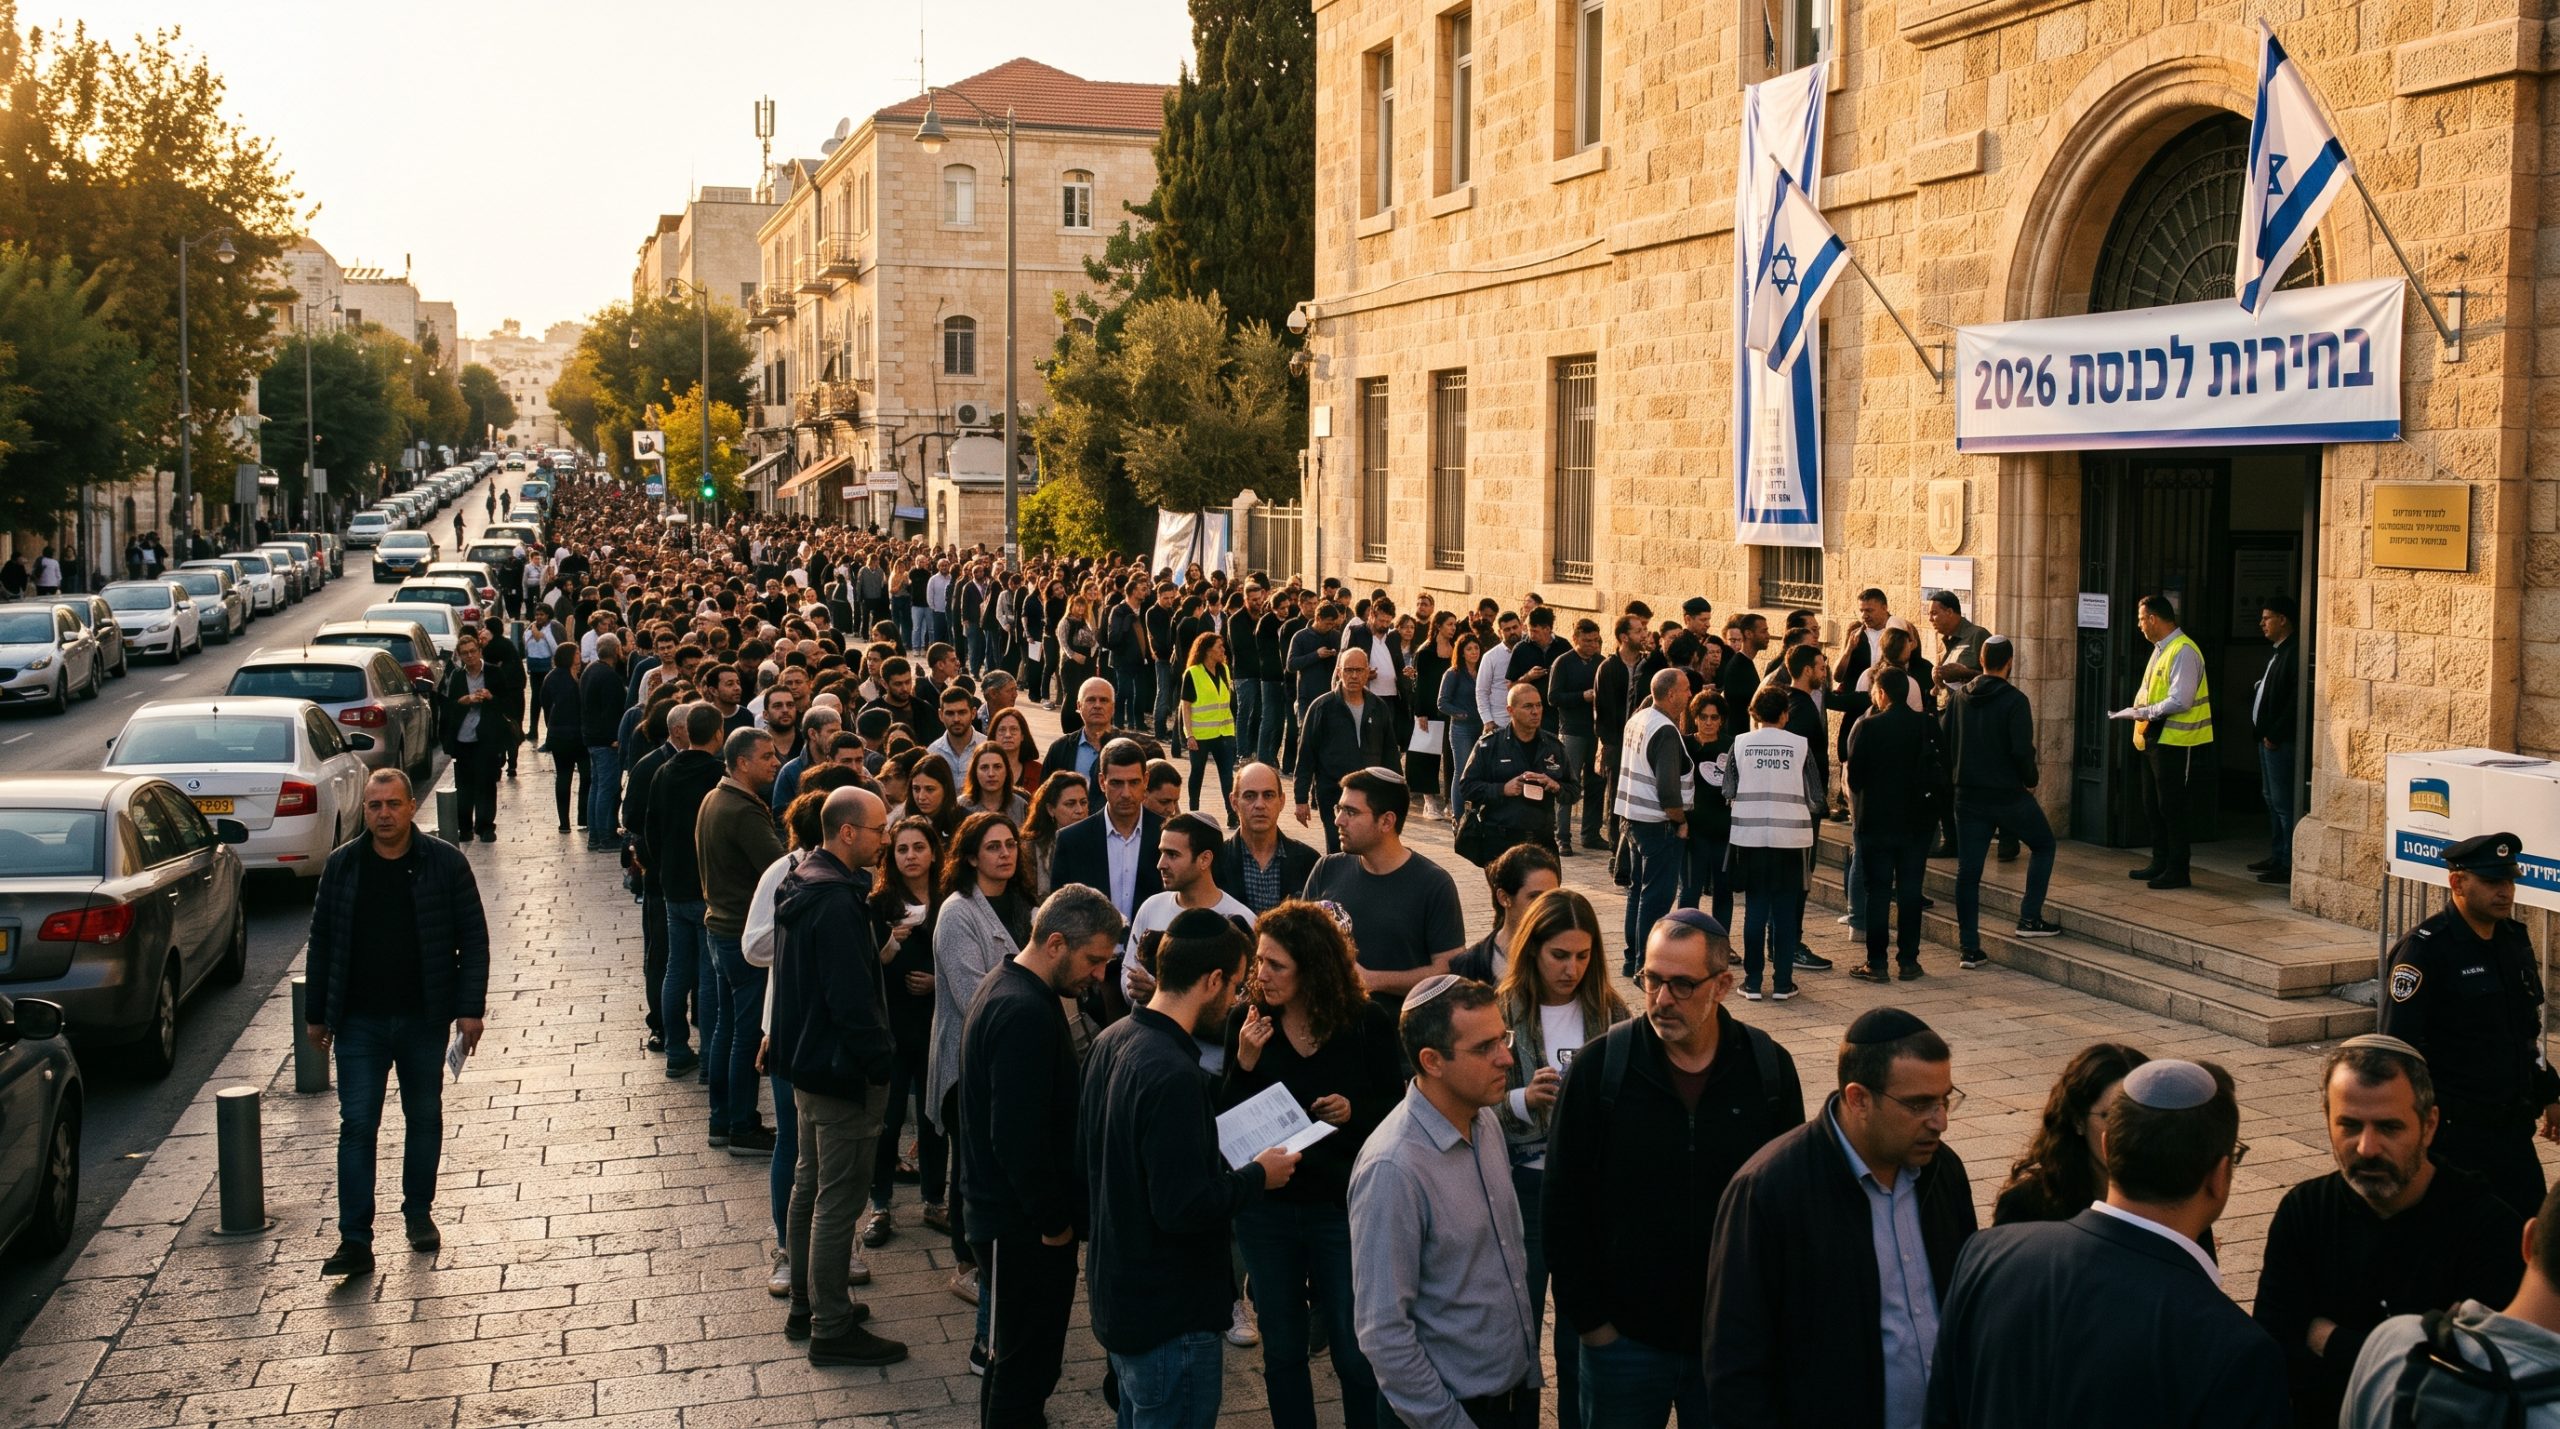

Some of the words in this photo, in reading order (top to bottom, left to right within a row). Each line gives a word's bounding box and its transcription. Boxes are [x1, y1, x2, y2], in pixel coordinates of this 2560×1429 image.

[1974, 354, 2057, 410] 2026
[2067, 334, 2194, 406] לכנסת
[2207, 327, 2374, 398] בחירות
